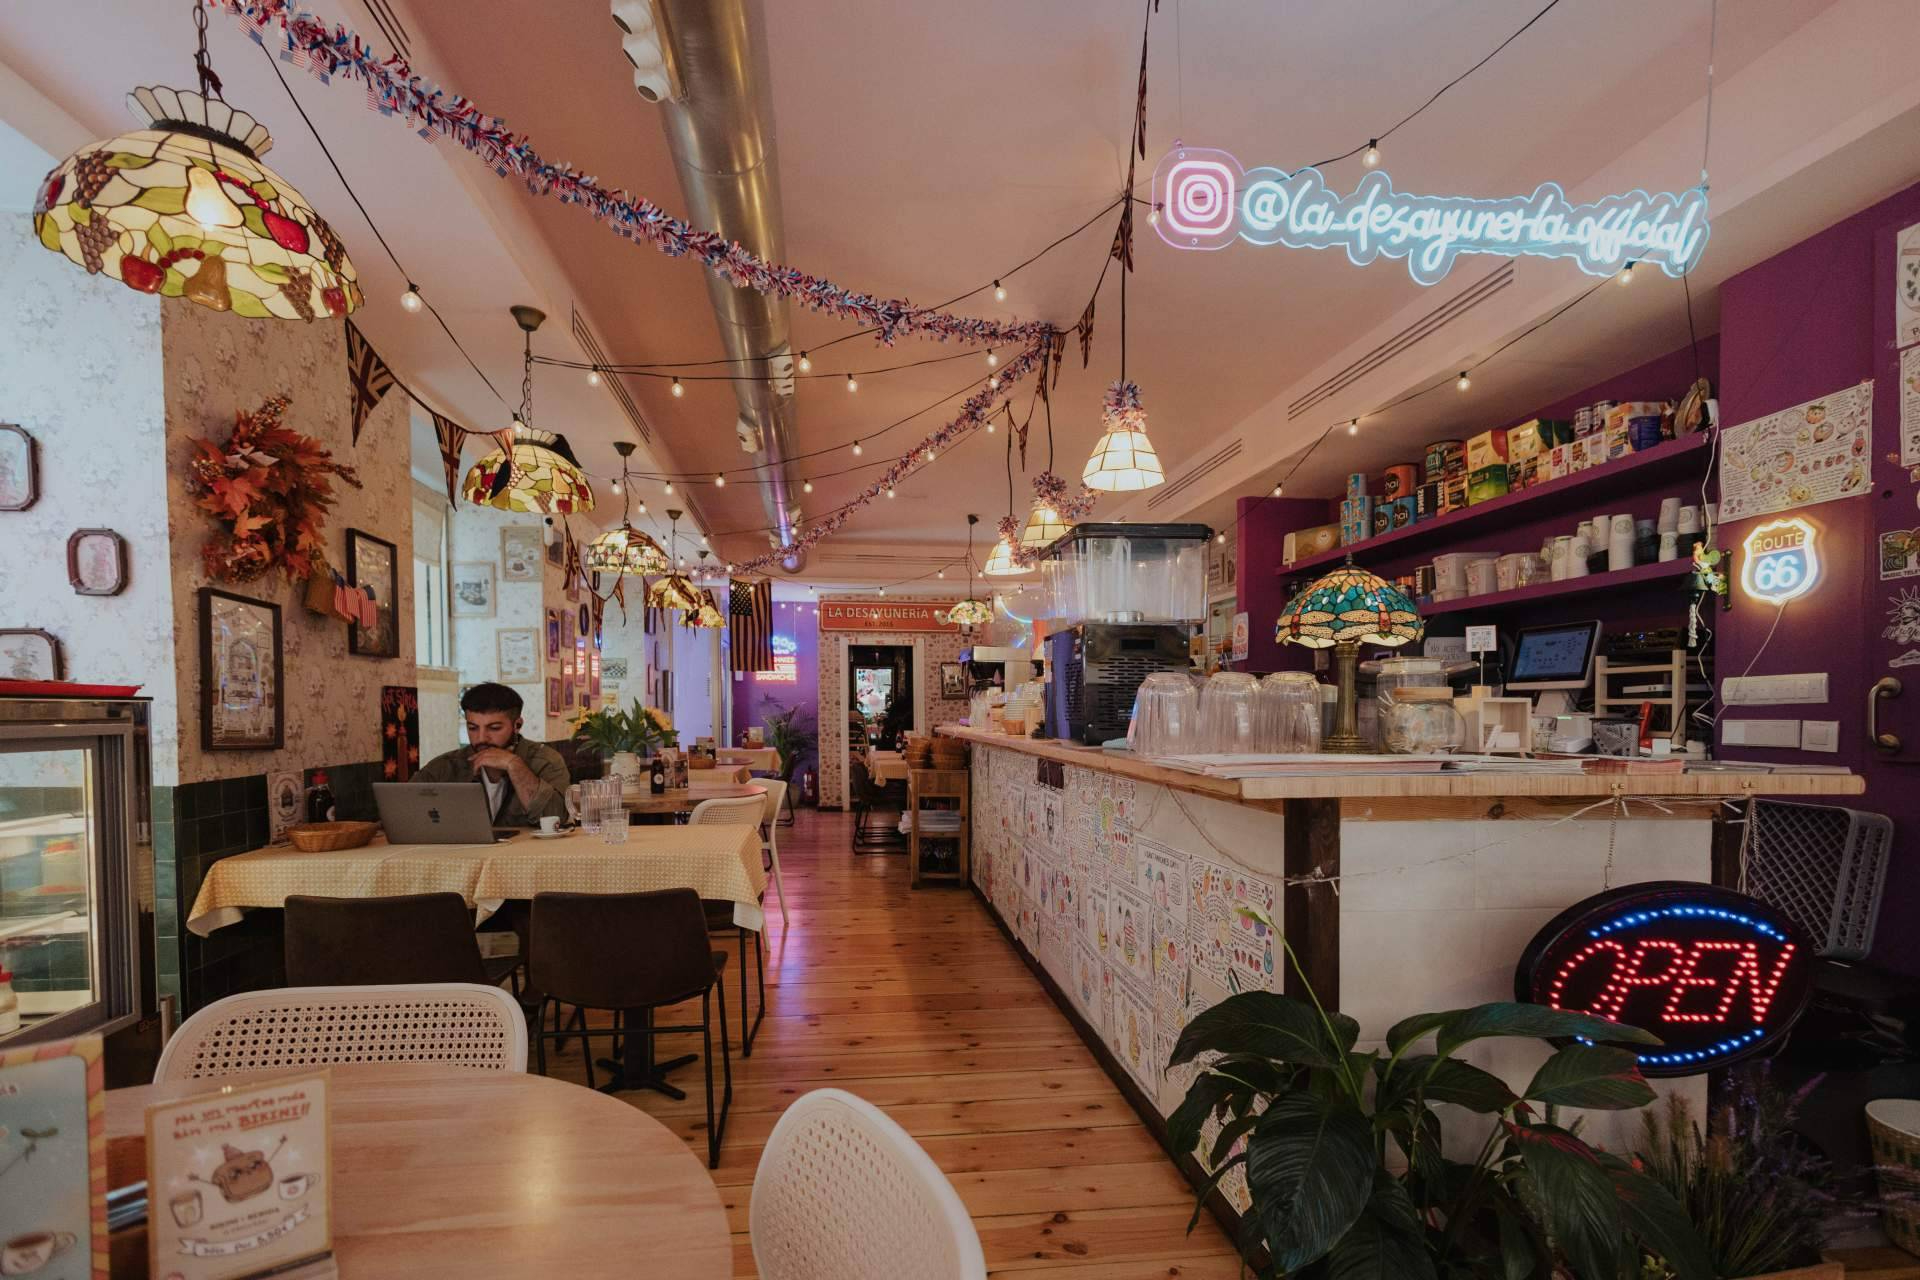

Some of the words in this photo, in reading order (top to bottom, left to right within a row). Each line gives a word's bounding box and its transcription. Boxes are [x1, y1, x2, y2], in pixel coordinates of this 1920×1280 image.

[1753, 532, 1805, 553] ROUTE
[1755, 554, 1799, 591] 66
[828, 607, 842, 618] LA
[1550, 940, 1796, 1022] OPEN
